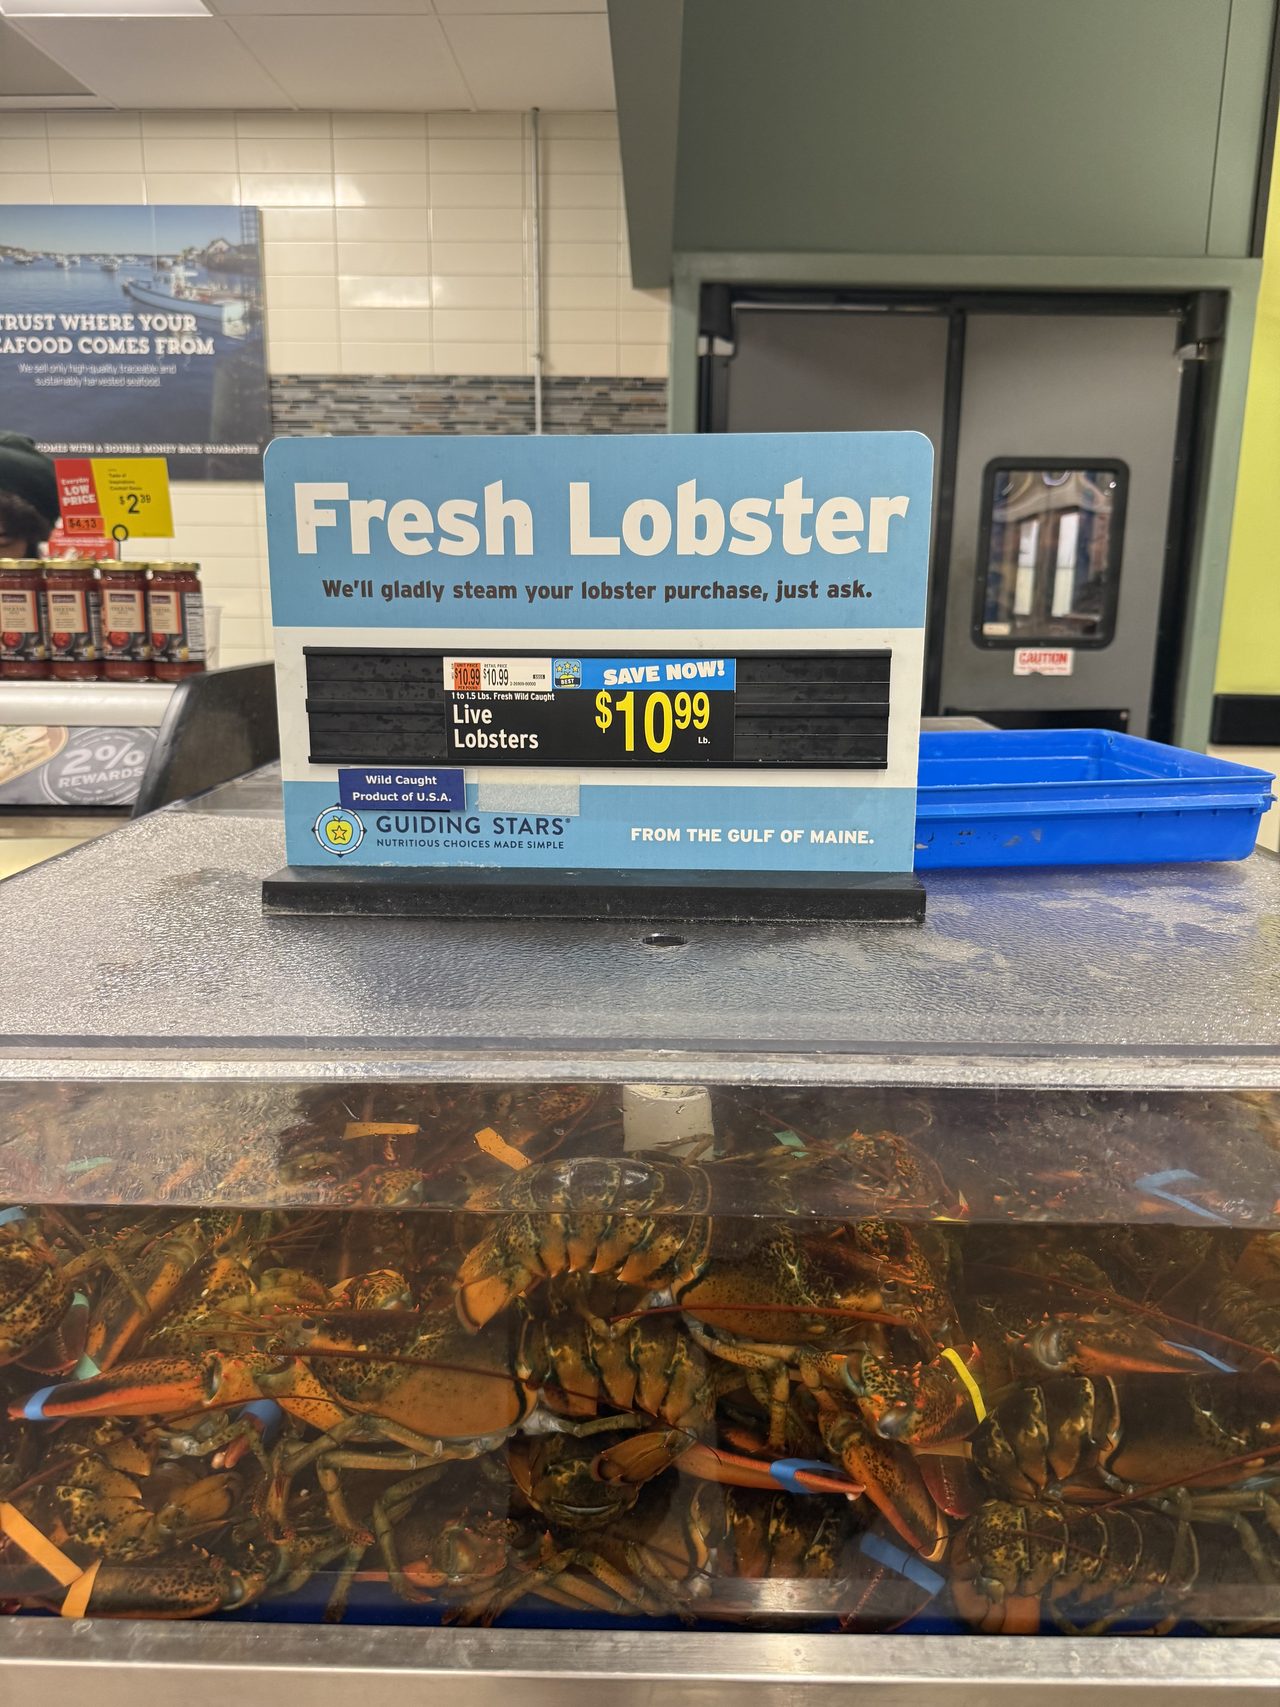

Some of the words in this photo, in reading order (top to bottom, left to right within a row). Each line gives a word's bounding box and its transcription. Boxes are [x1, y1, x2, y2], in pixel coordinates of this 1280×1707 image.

[59, 313, 135, 331] WHERE
[137, 313, 198, 332] YOUR
[0, 336, 74, 354] AFOOD
[78, 336, 151, 354] COMES
[155, 337, 216, 355] FROM
[18, 363, 33, 374] We
[50, 363, 67, 376] only
[159, 364, 177, 375] and
[34, 376, 82, 388] sustainably
[69, 443, 95, 454] WITH
[96, 444, 104, 454] A
[105, 443, 142, 454] DOUBLE
[143, 443, 177, 455] MONEY
[178, 444, 203, 455] BACK
[61, 478, 90, 486] Everyday
[64, 485, 90, 496] LOW
[62, 494, 97, 507] PRICE
[68, 518, 97, 529] $4.13
[294, 479, 534, 556] Fresh
[569, 477, 910, 556] Lobster
[322, 579, 374, 598] We'll
[381, 579, 445, 602] gladly
[453, 581, 517, 599] steam
[525, 584, 573, 603] your
[582, 580, 657, 600] lobster
[664, 580, 769, 603] purchase,
[775, 579, 819, 603] just
[827, 579, 872, 599] ask.
[1018, 652, 1068, 665] CAUTION
[454, 668, 481, 686] $10.99
[483, 668, 509, 686] $10.99
[603, 665, 661, 686] SAVE
[665, 660, 726, 681] NOW!
[456, 692, 465, 700] to
[466, 692, 476, 700] 1.5
[477, 692, 492, 700] Lbs.
[493, 692, 513, 700] Fresh
[513, 692, 529, 701] Wild
[530, 693, 555, 702] Caught
[453, 704, 493, 724] Live
[454, 728, 539, 750] Lobsters
[698, 736, 711, 744] Lb.
[61, 742, 146, 775] 2%
[58, 766, 145, 789] REWARDS
[365, 775, 394, 785] Wild
[396, 775, 437, 788] Caught
[352, 791, 399, 802] Product
[401, 792, 413, 802] of
[416, 792, 452, 802] U.S.A.
[376, 815, 481, 834] GUIDING
[631, 827, 681, 842] FROM
[686, 828, 722, 842] THE
[727, 828, 775, 843] GULF
[780, 829, 804, 843] OF
[810, 830, 874, 844] MAINE.
[376, 838, 441, 848] NUTRITIOUS
[443, 839, 490, 849] CHOICES
[494, 840, 525, 849] MADE
[527, 840, 565, 849] SIMPLE
